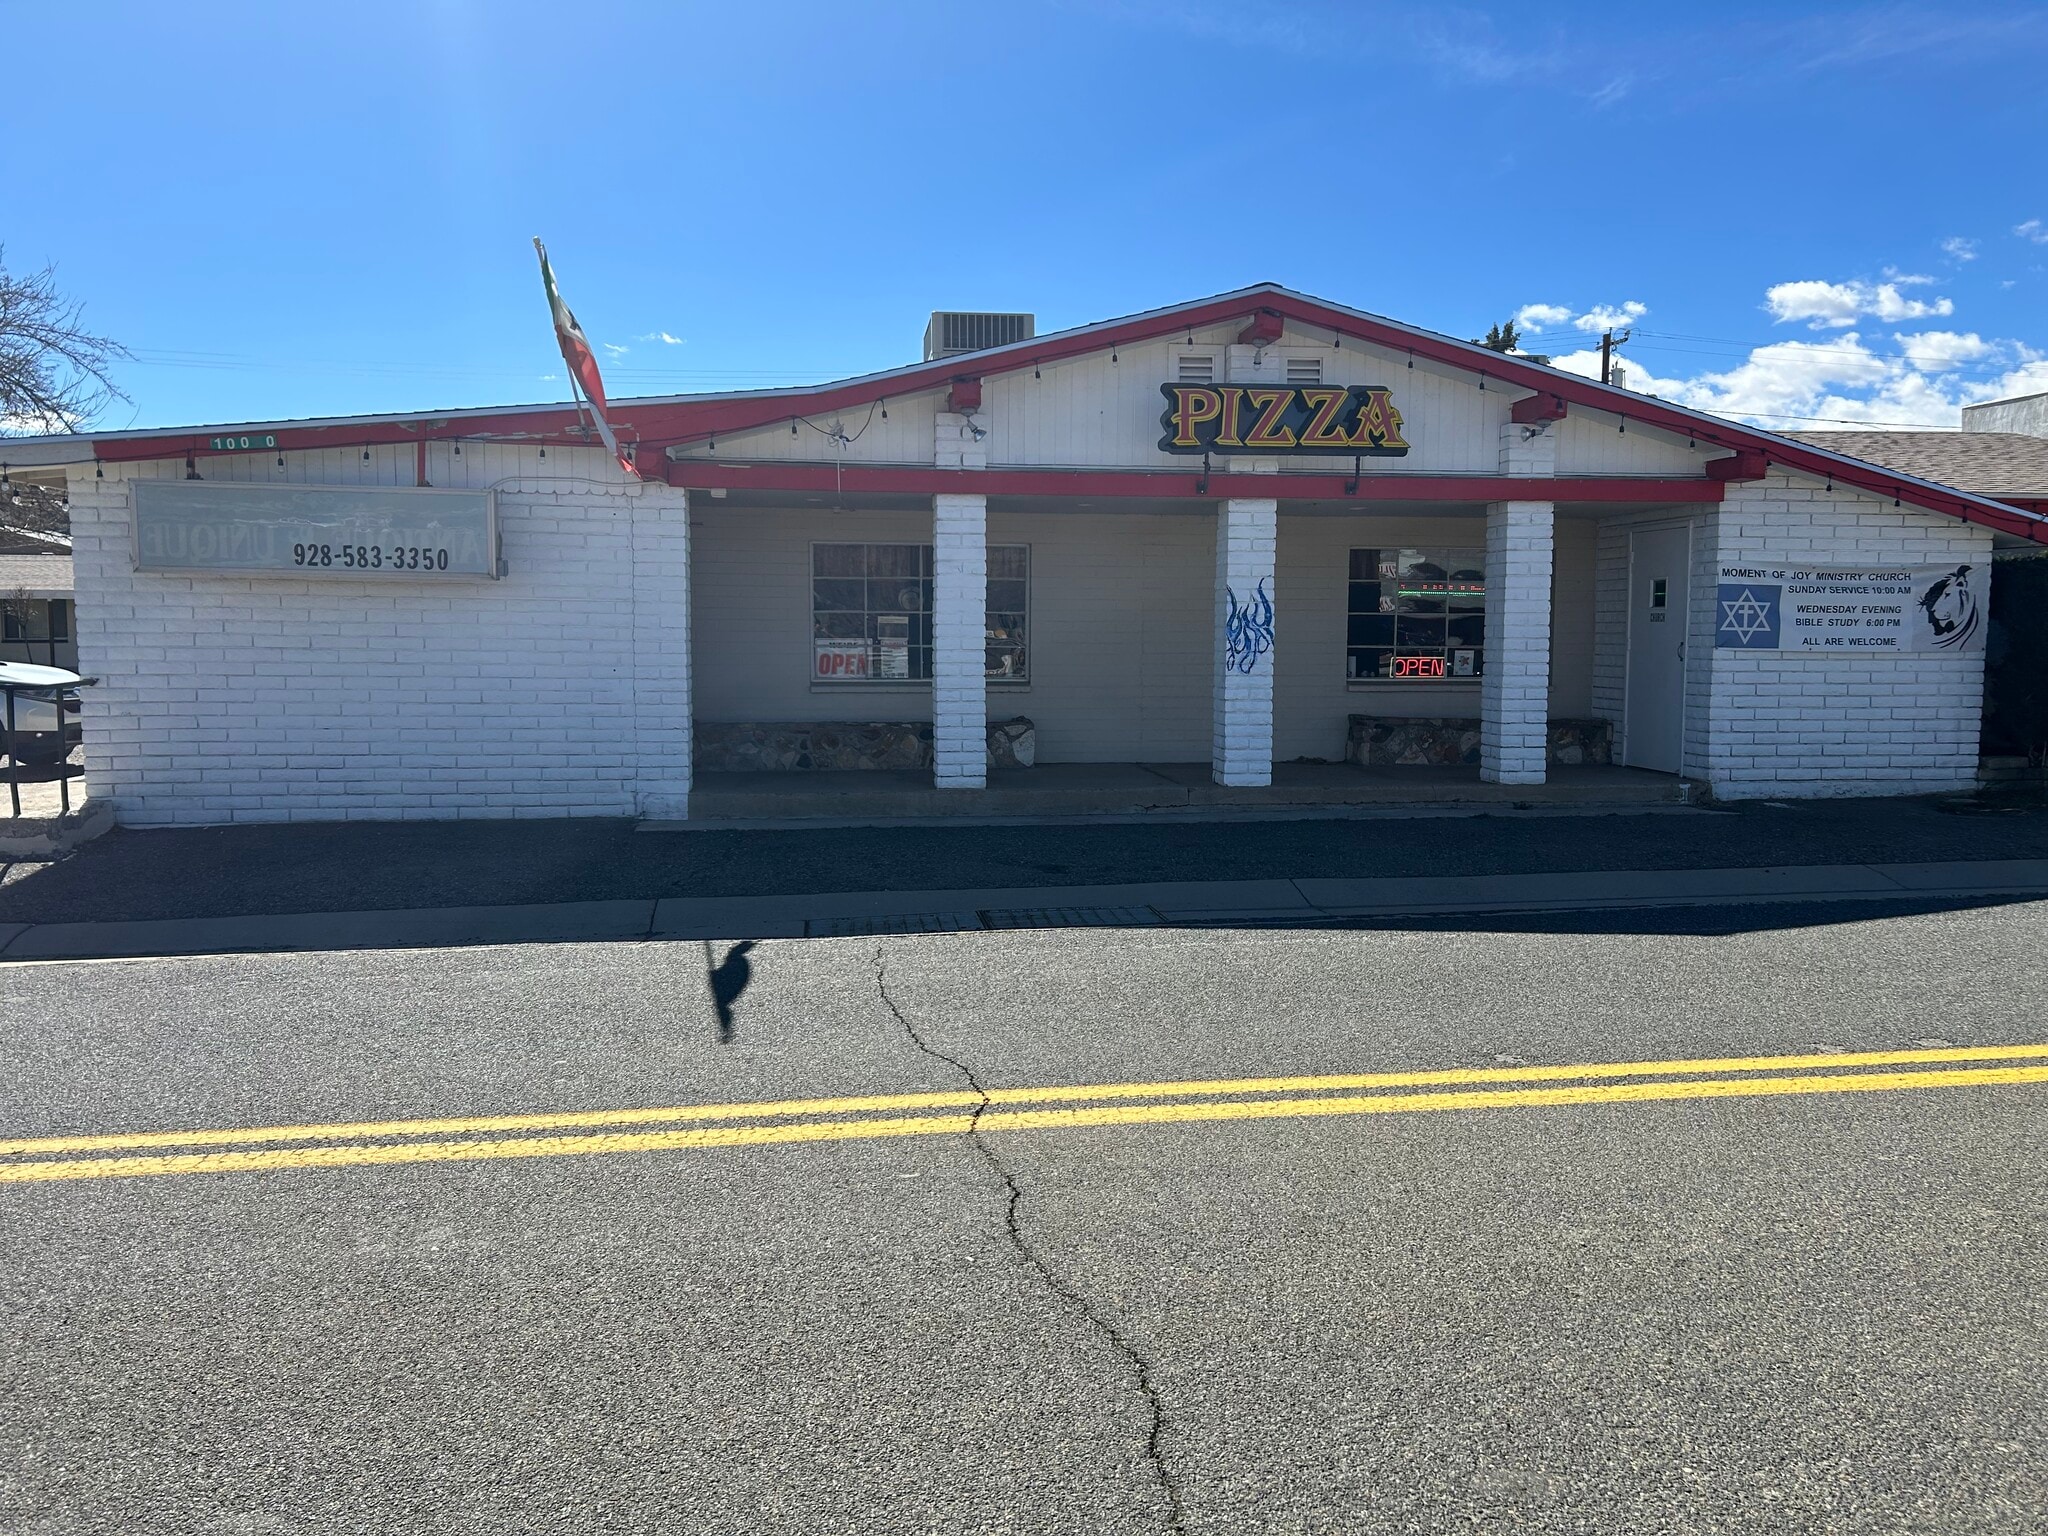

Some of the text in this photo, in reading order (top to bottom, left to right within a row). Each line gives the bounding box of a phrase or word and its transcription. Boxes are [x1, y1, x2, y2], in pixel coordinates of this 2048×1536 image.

[1171, 388, 1411, 448] PIZZA
[294, 543, 449, 571] 928-583-3350
[1722, 568, 1911, 581] MOMENT OF JOY MINISTRY CHURCH
[1788, 585, 1911, 595] SUNDAY SERVICE 10:00 AM
[1796, 605, 1902, 614] WEDNESDAY EVENING
[1795, 618, 1901, 627] BIBLE STUDY 6:00 PM
[1802, 637, 1897, 646] ALL ARE WELCOME
[818, 653, 869, 675] OPEN
[1395, 659, 1444, 676] OPEN
